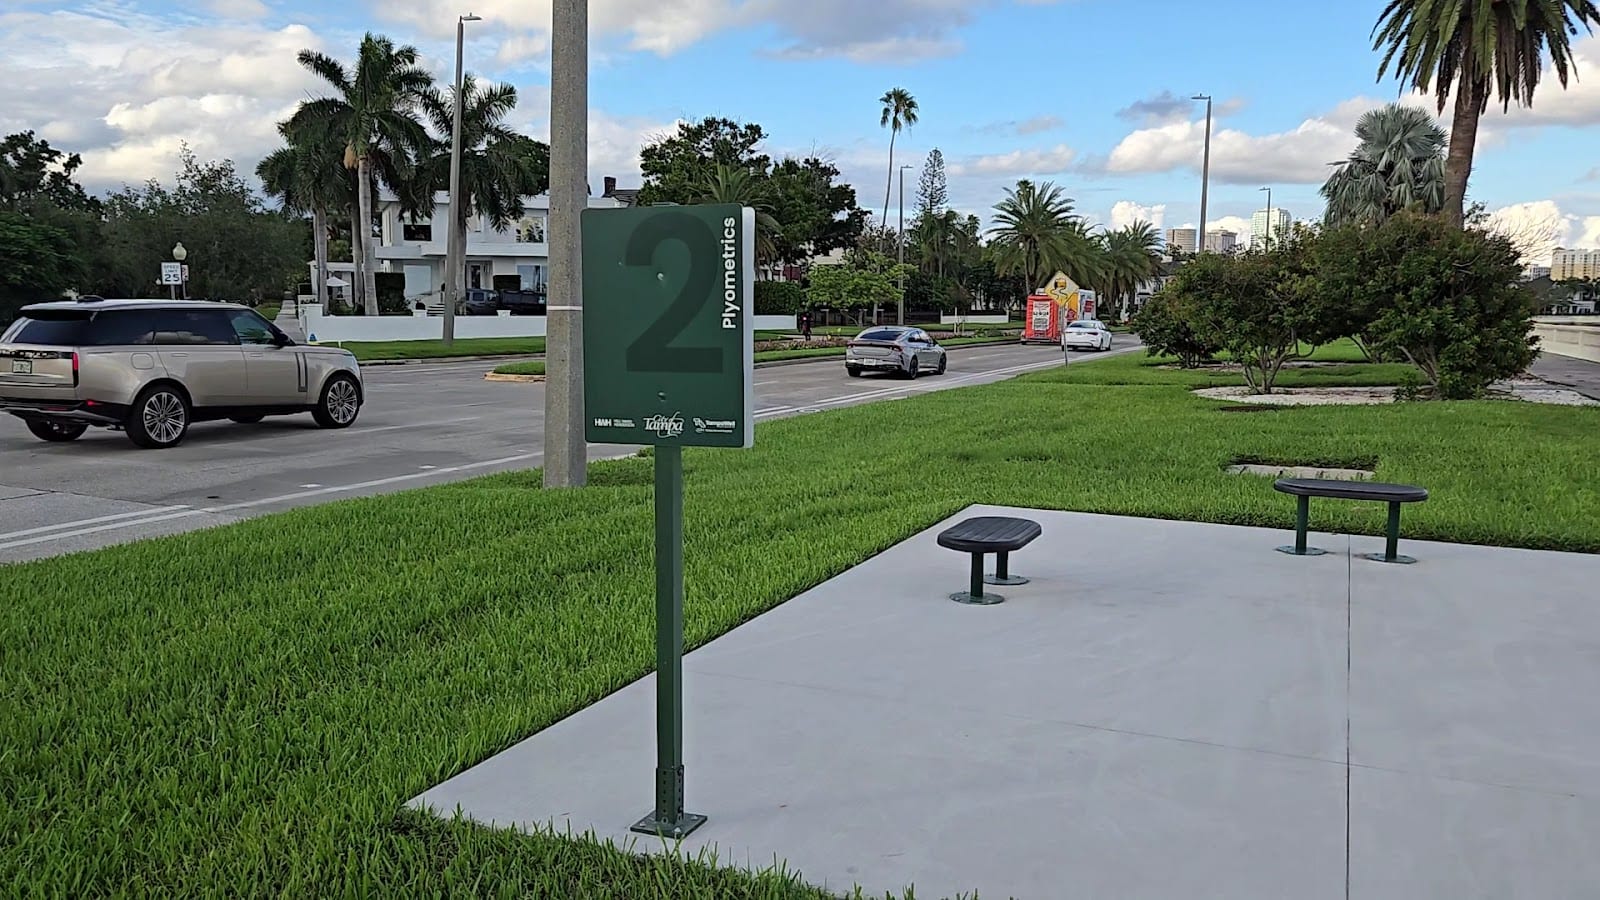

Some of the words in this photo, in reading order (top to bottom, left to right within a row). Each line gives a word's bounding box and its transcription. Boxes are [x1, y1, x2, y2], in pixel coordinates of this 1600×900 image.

[164, 273, 180, 282] 25
[625, 211, 723, 374] 2
[720, 217, 740, 329] Plyometrics
[643, 417, 685, 437] Tampa
